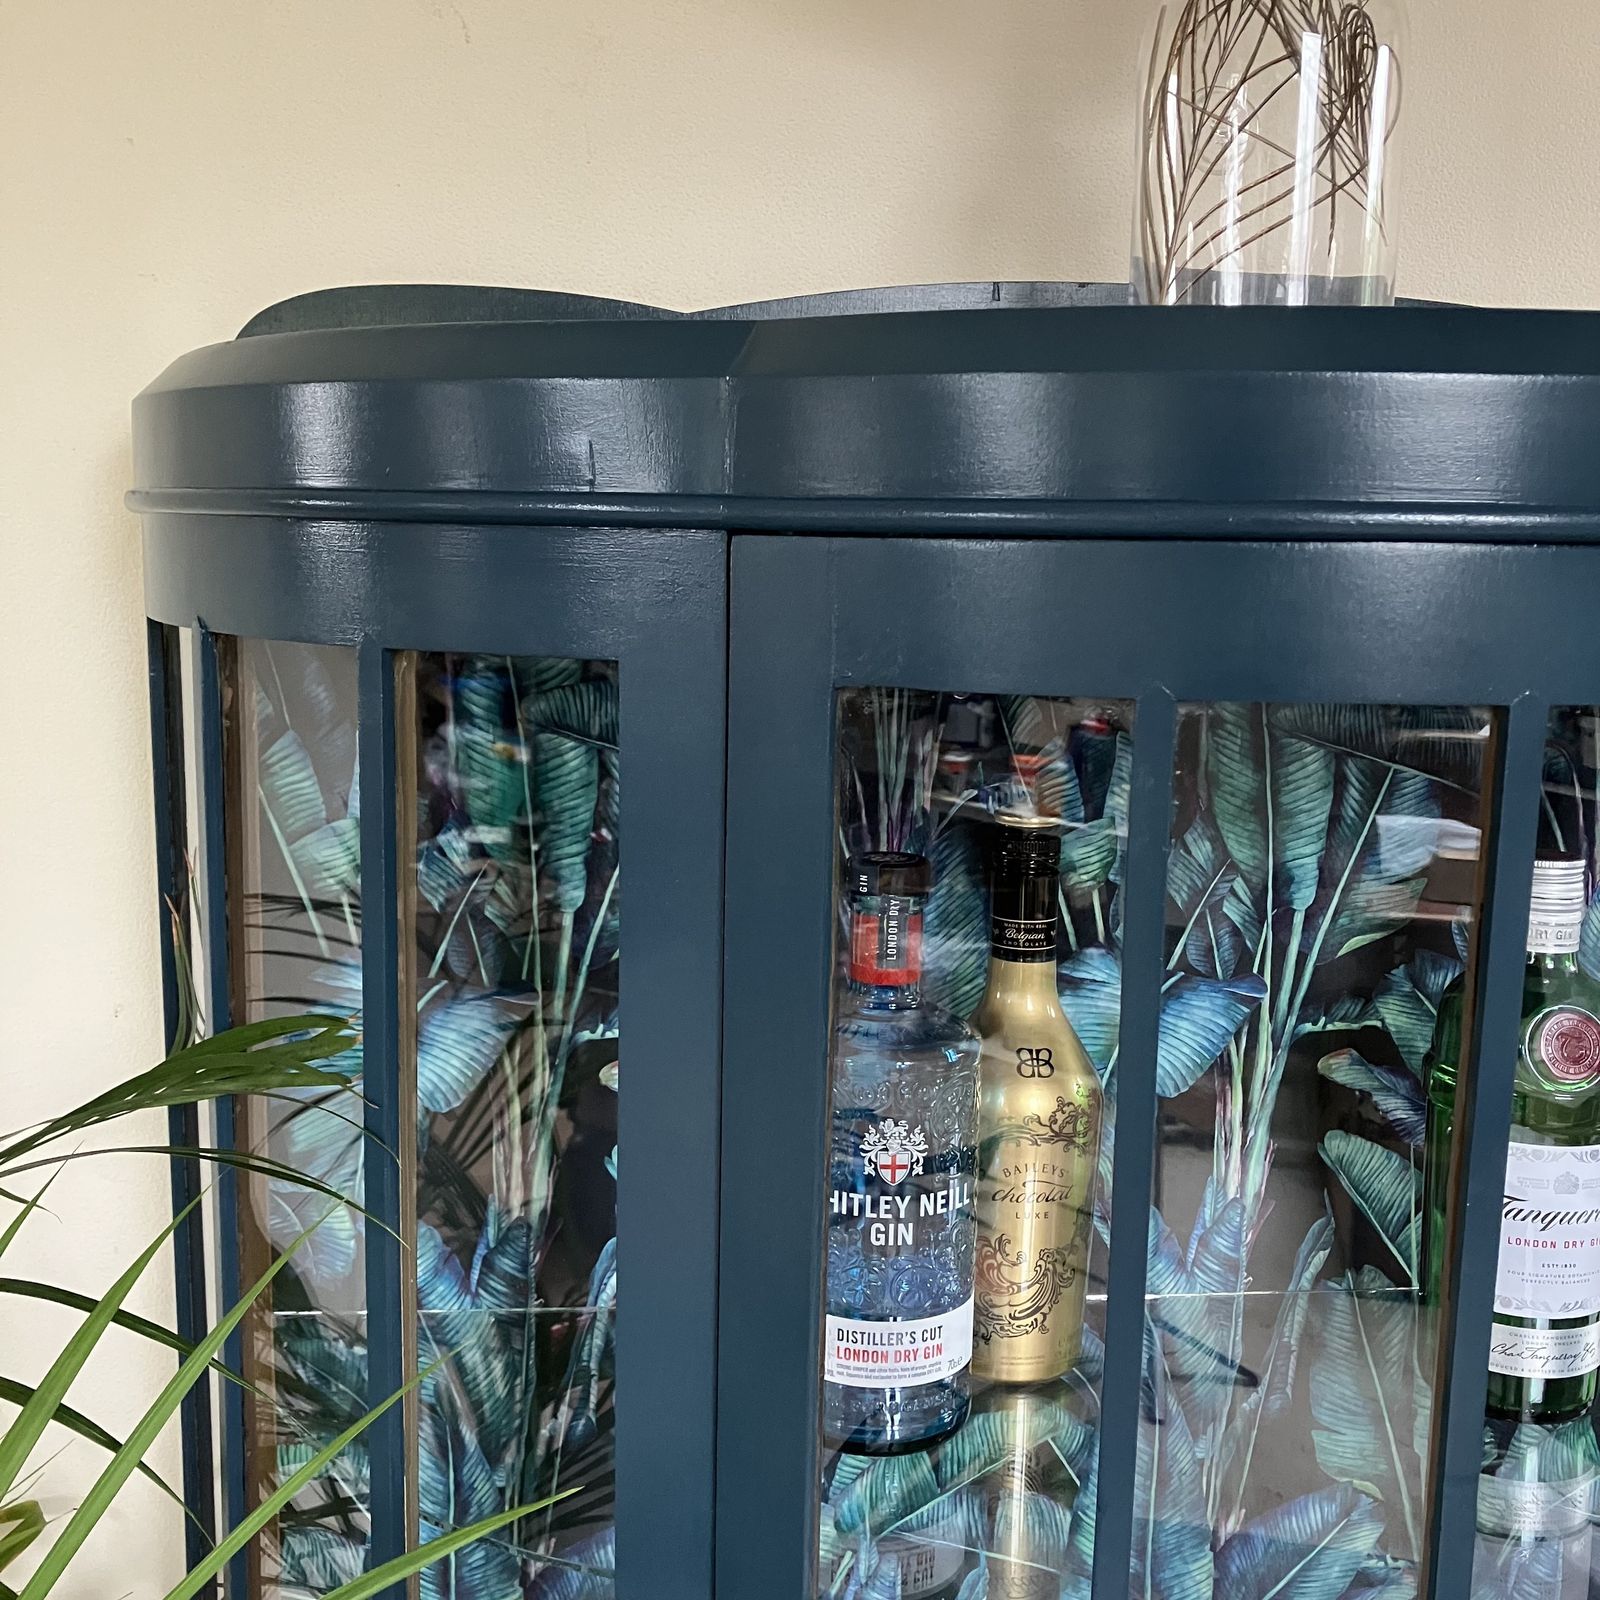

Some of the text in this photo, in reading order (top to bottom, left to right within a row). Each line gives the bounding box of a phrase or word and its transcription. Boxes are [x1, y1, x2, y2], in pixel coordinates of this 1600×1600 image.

[859, 874, 869, 893] GIN
[887, 899, 901, 961] LONDON DRY
[1004, 927, 1046, 942] Belgian
[1003, 1163, 1066, 1179] BAILEYS
[919, 1183, 971, 1218] NEILL
[992, 1180, 1074, 1204] chocolat
[1015, 1211, 1049, 1220] LUXE
[1502, 1194, 1600, 1232] Tanquer
[870, 1222, 914, 1246] GIN
[1507, 1236, 1600, 1249] LONDON DRY GI
[837, 1325, 943, 1346] DISTILLER'S CUT
[836, 1345, 889, 1364] LONDON
[893, 1348, 919, 1364] DRY
[923, 1343, 943, 1360] GIN
